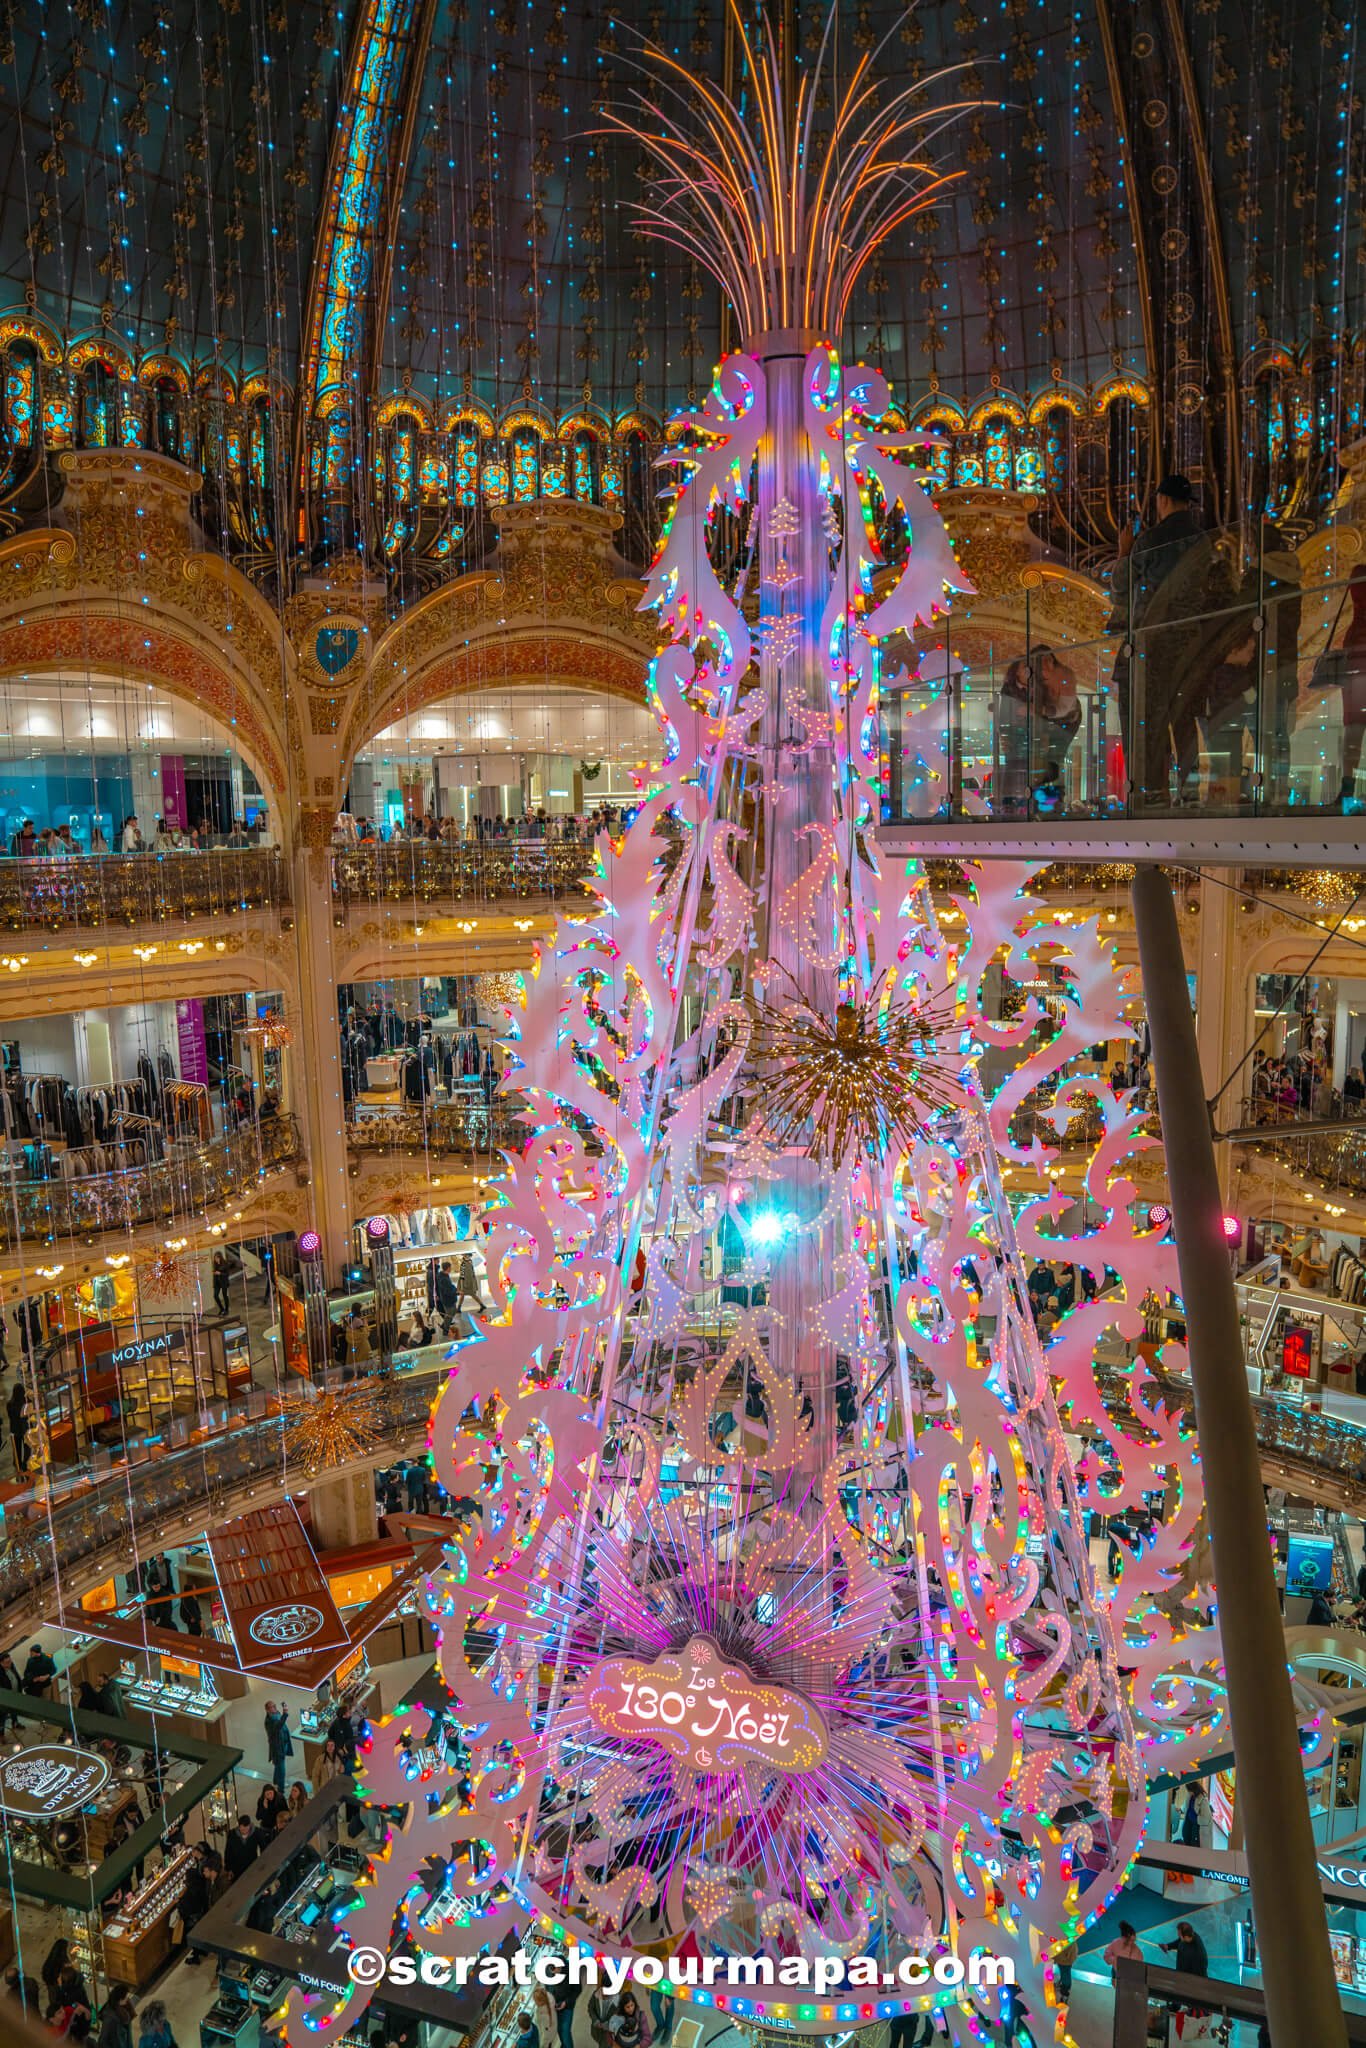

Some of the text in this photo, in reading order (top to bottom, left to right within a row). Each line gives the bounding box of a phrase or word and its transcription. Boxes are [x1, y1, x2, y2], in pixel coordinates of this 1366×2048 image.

[112, 1334, 173, 1364] MOYNAT
[279, 1623, 298, 1637] H
[687, 1666, 716, 1690] Le
[691, 1695, 790, 1747] Noël
[41, 1765, 98, 1811] DIPTYQUE
[298, 1972, 346, 1996] TOM FORD
